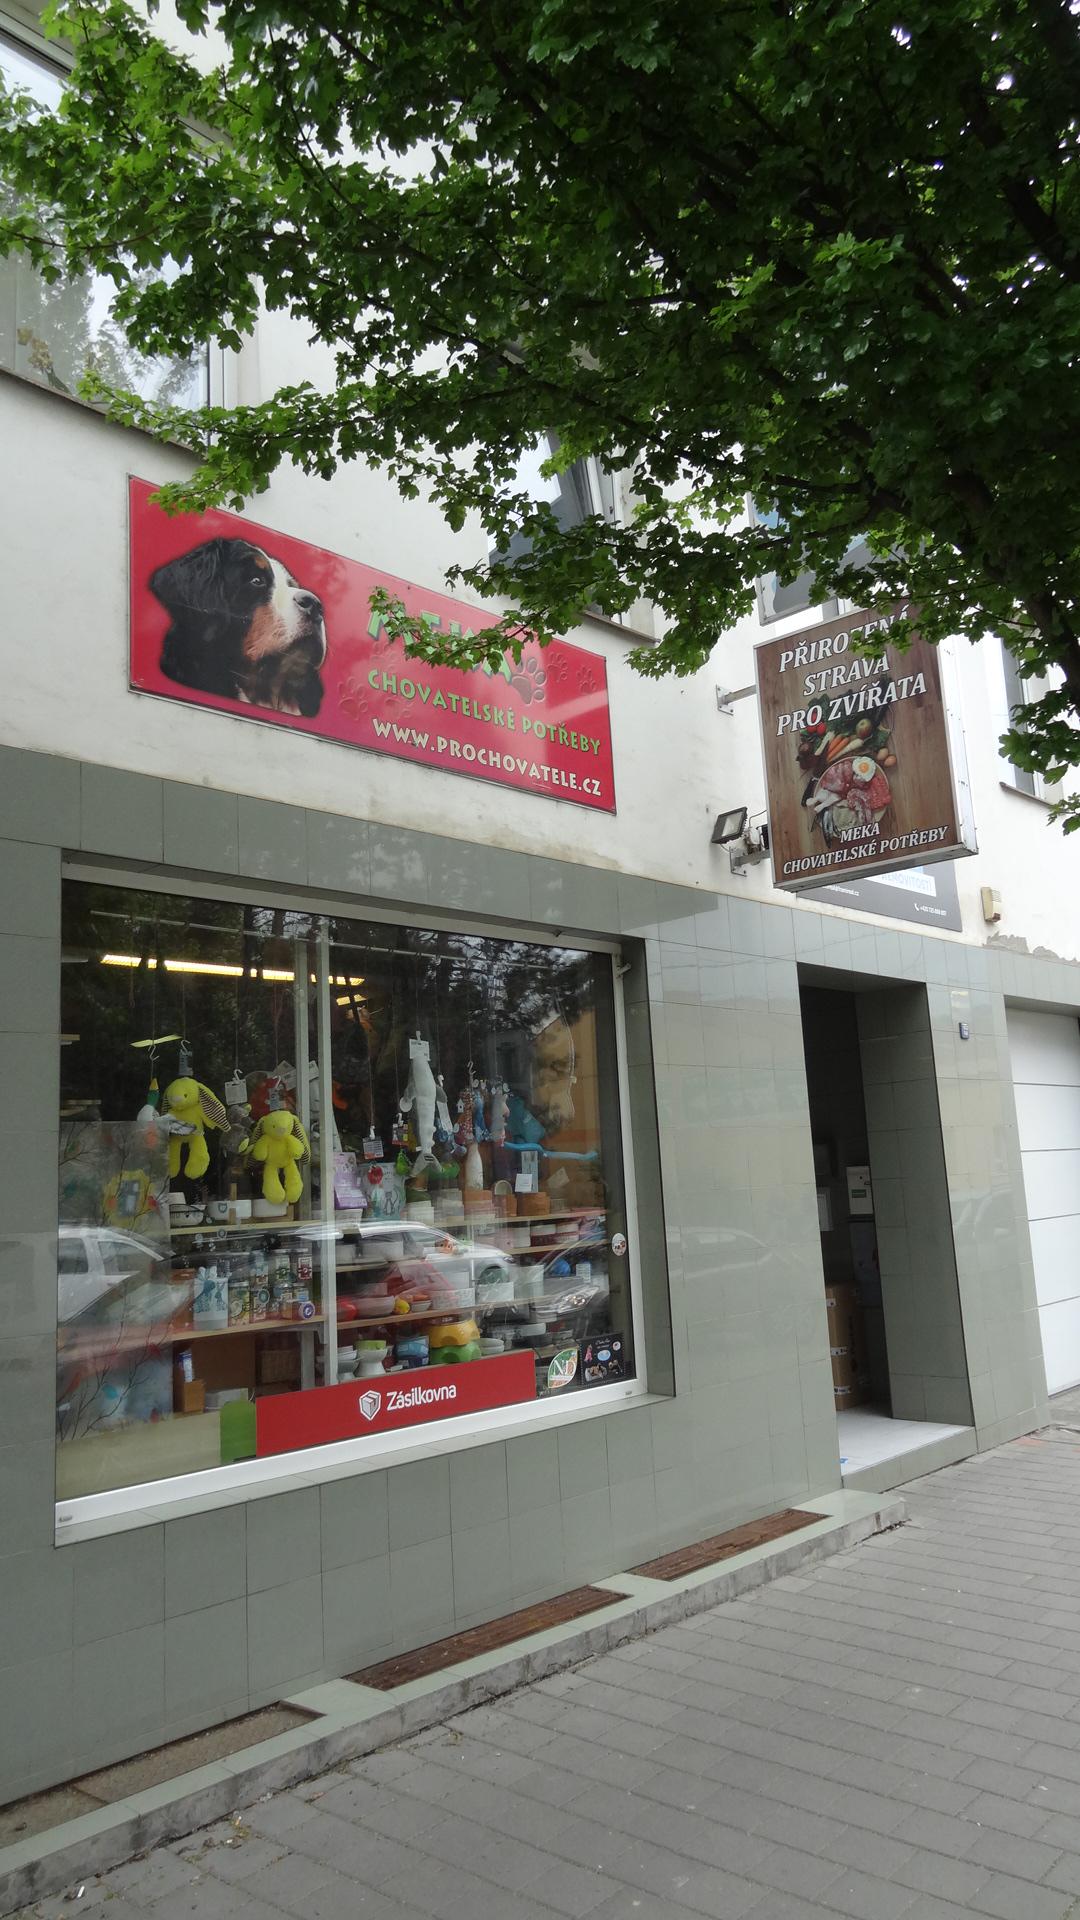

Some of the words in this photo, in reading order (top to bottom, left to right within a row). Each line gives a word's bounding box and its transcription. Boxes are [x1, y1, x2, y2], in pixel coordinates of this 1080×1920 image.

[802, 651, 890, 696] STRAVA
[368, 669, 516, 731] CHOVATELSKÉ
[522, 716, 601, 755] POTŘEBY
[776, 705, 823, 737] PRO
[828, 673, 927, 722] ZVÍŘATA
[372, 718, 602, 797] WWW.PROCHOVATELE.CZ
[783, 840, 877, 875] CHOVATELSKÉ
[880, 826, 949, 854] POTŘEBY
[840, 823, 880, 843] MEKA
[386, 1385, 457, 1411] Zásilkovna
